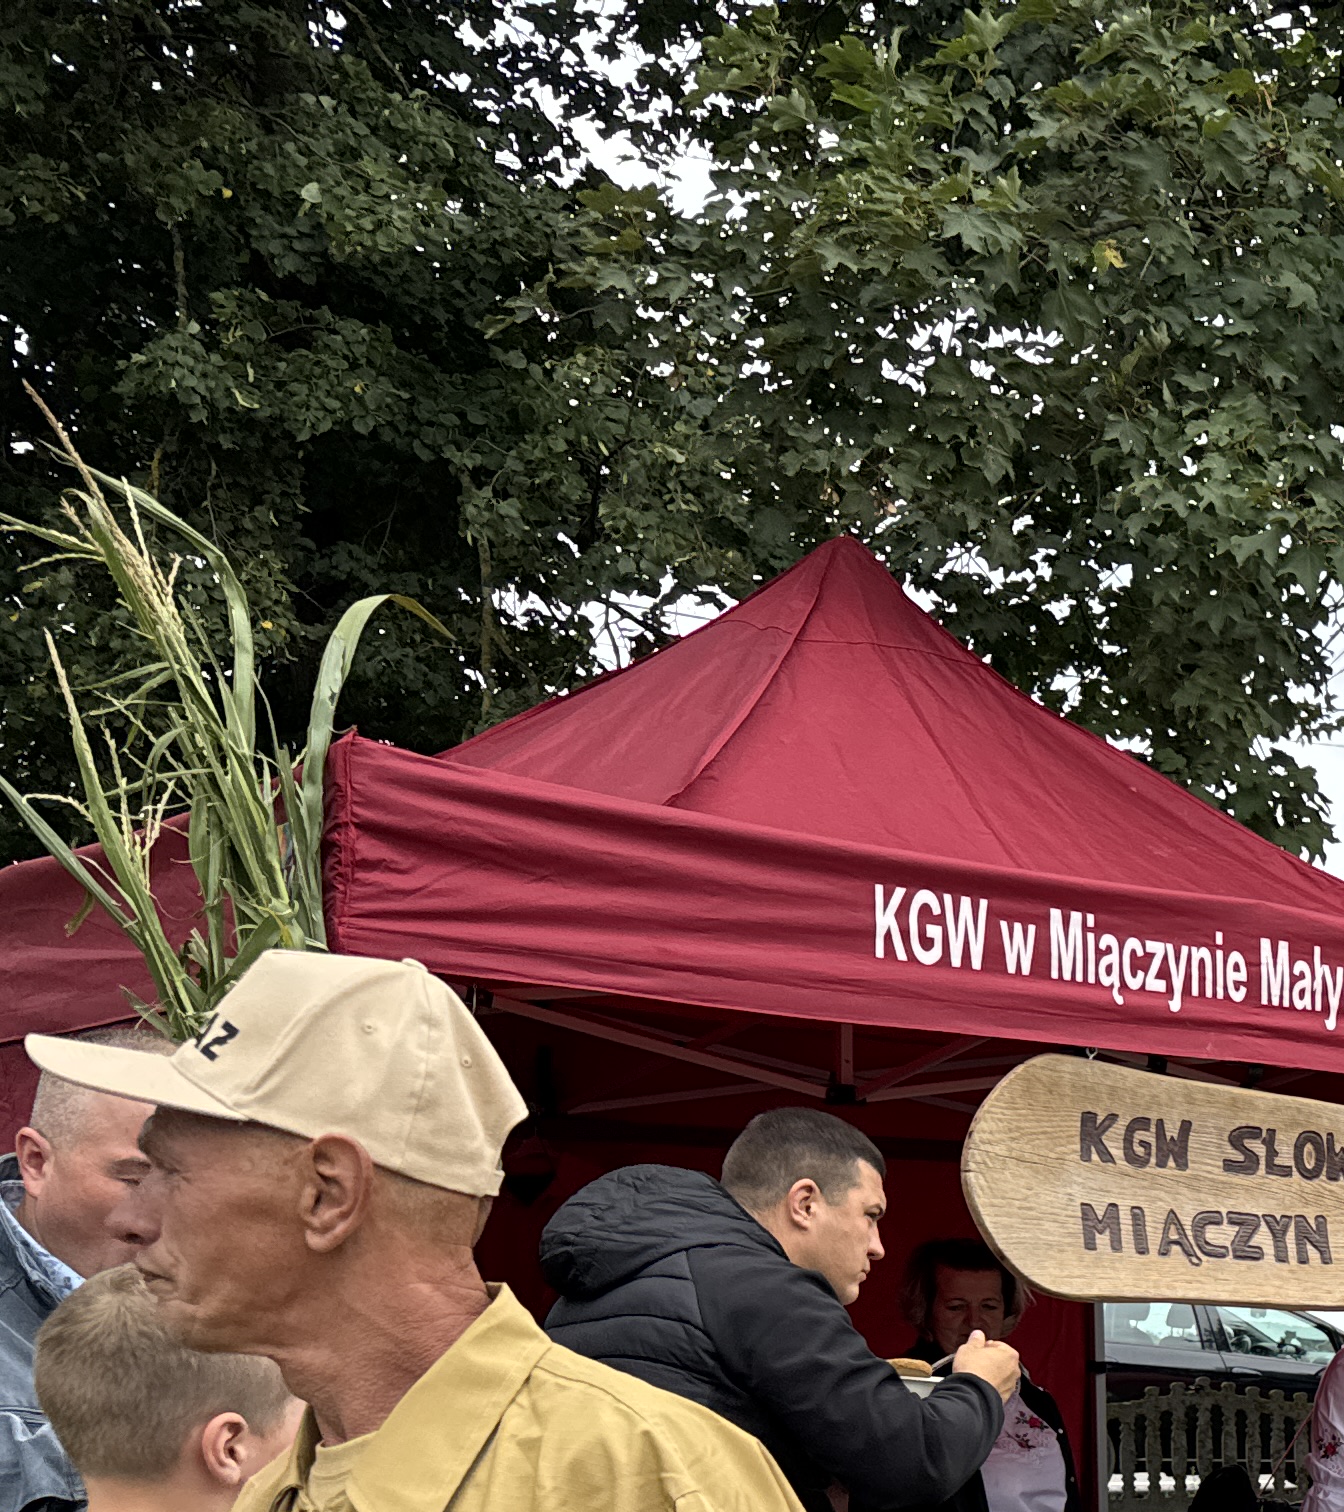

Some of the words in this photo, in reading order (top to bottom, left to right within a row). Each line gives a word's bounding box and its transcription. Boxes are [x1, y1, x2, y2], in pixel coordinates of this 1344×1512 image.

[873, 884, 988, 970] KGW
[1000, 919, 1035, 976] w
[1050, 908, 1248, 1012] Miączynie
[1079, 1111, 1192, 1171] KGW
[1080, 1203, 1333, 1267] MIĄCZYN
